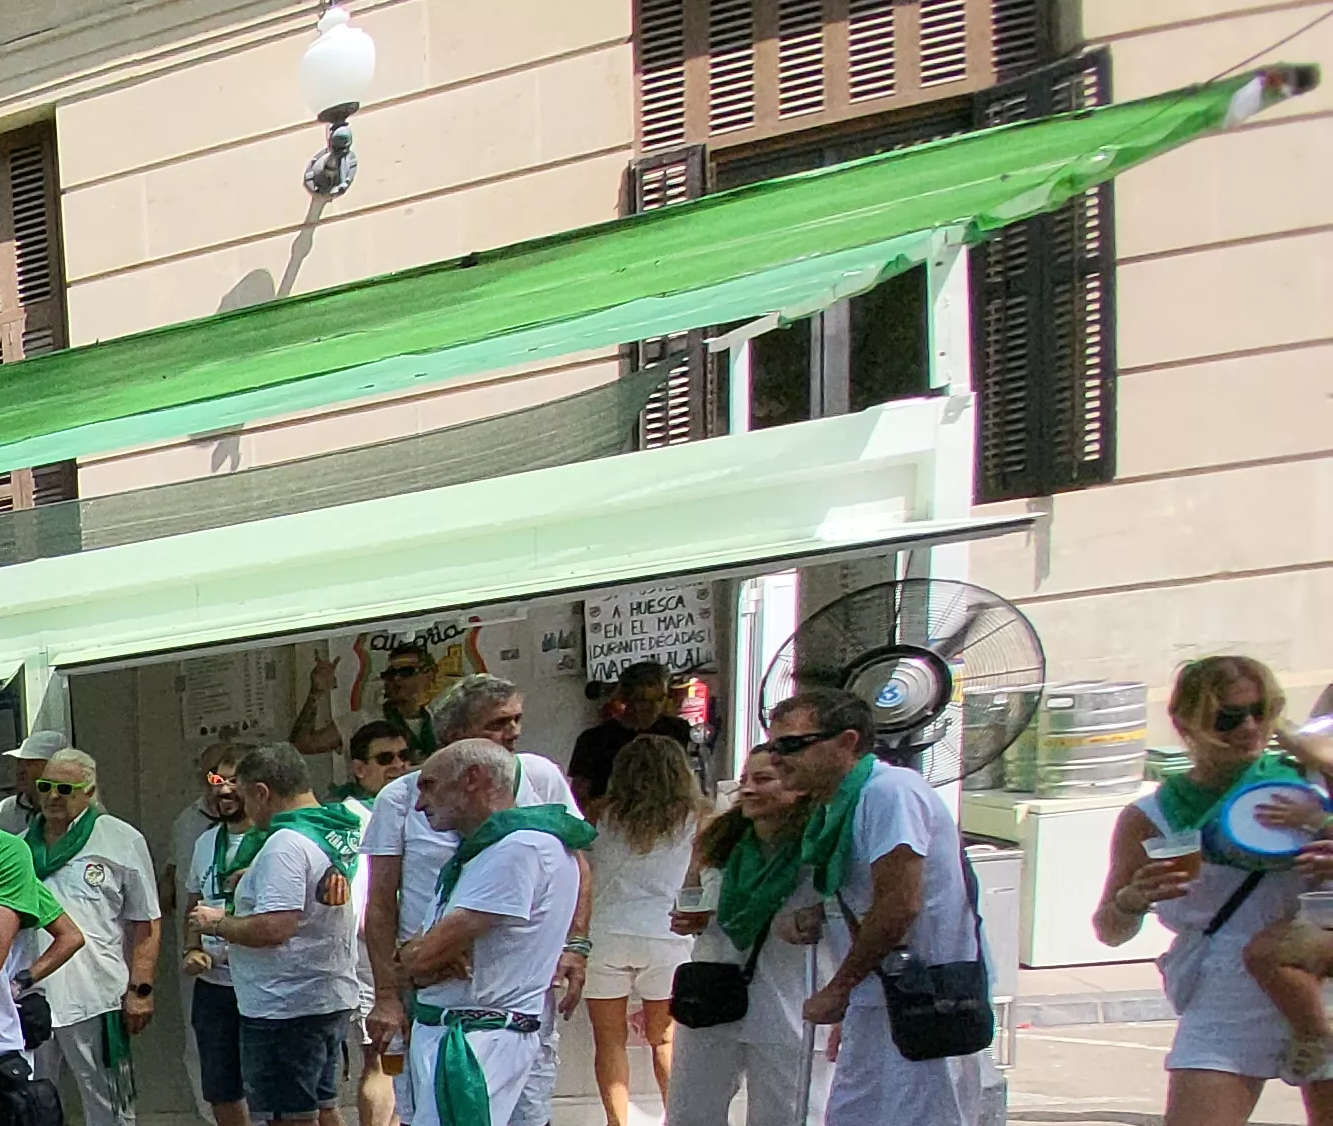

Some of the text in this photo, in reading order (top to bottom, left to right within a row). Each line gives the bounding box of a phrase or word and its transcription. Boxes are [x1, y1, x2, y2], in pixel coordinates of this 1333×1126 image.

[630, 594, 686, 617] HUESCA
[604, 611, 696, 639] EN EL MAPA
